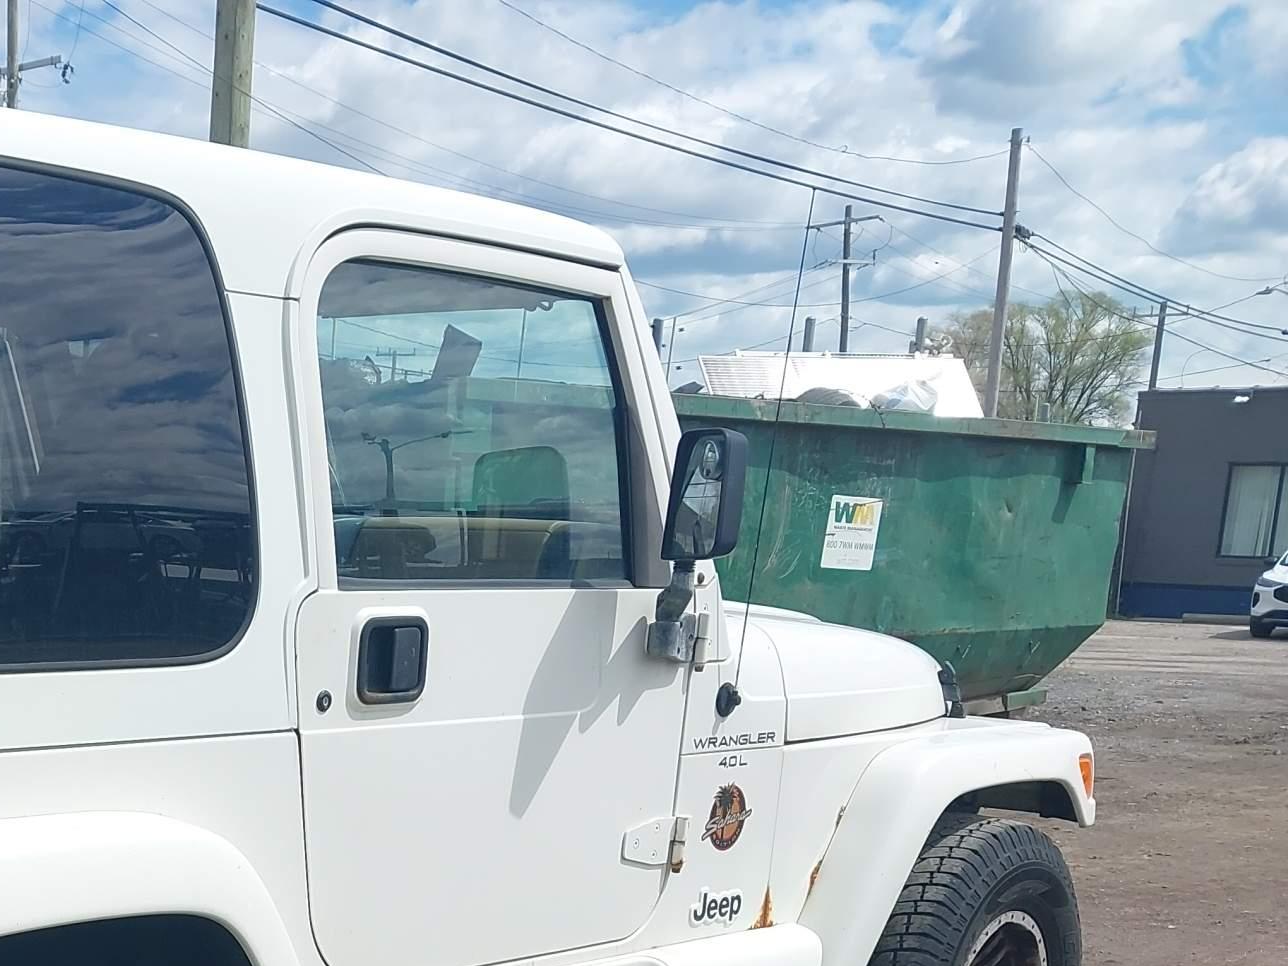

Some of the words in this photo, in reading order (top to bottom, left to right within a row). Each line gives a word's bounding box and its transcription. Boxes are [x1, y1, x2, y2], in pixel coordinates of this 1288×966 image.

[834, 501, 875, 527] WM
[693, 731, 776, 750] WRANGLER
[701, 808, 753, 842] Sahara
[693, 892, 742, 922] Jeep
